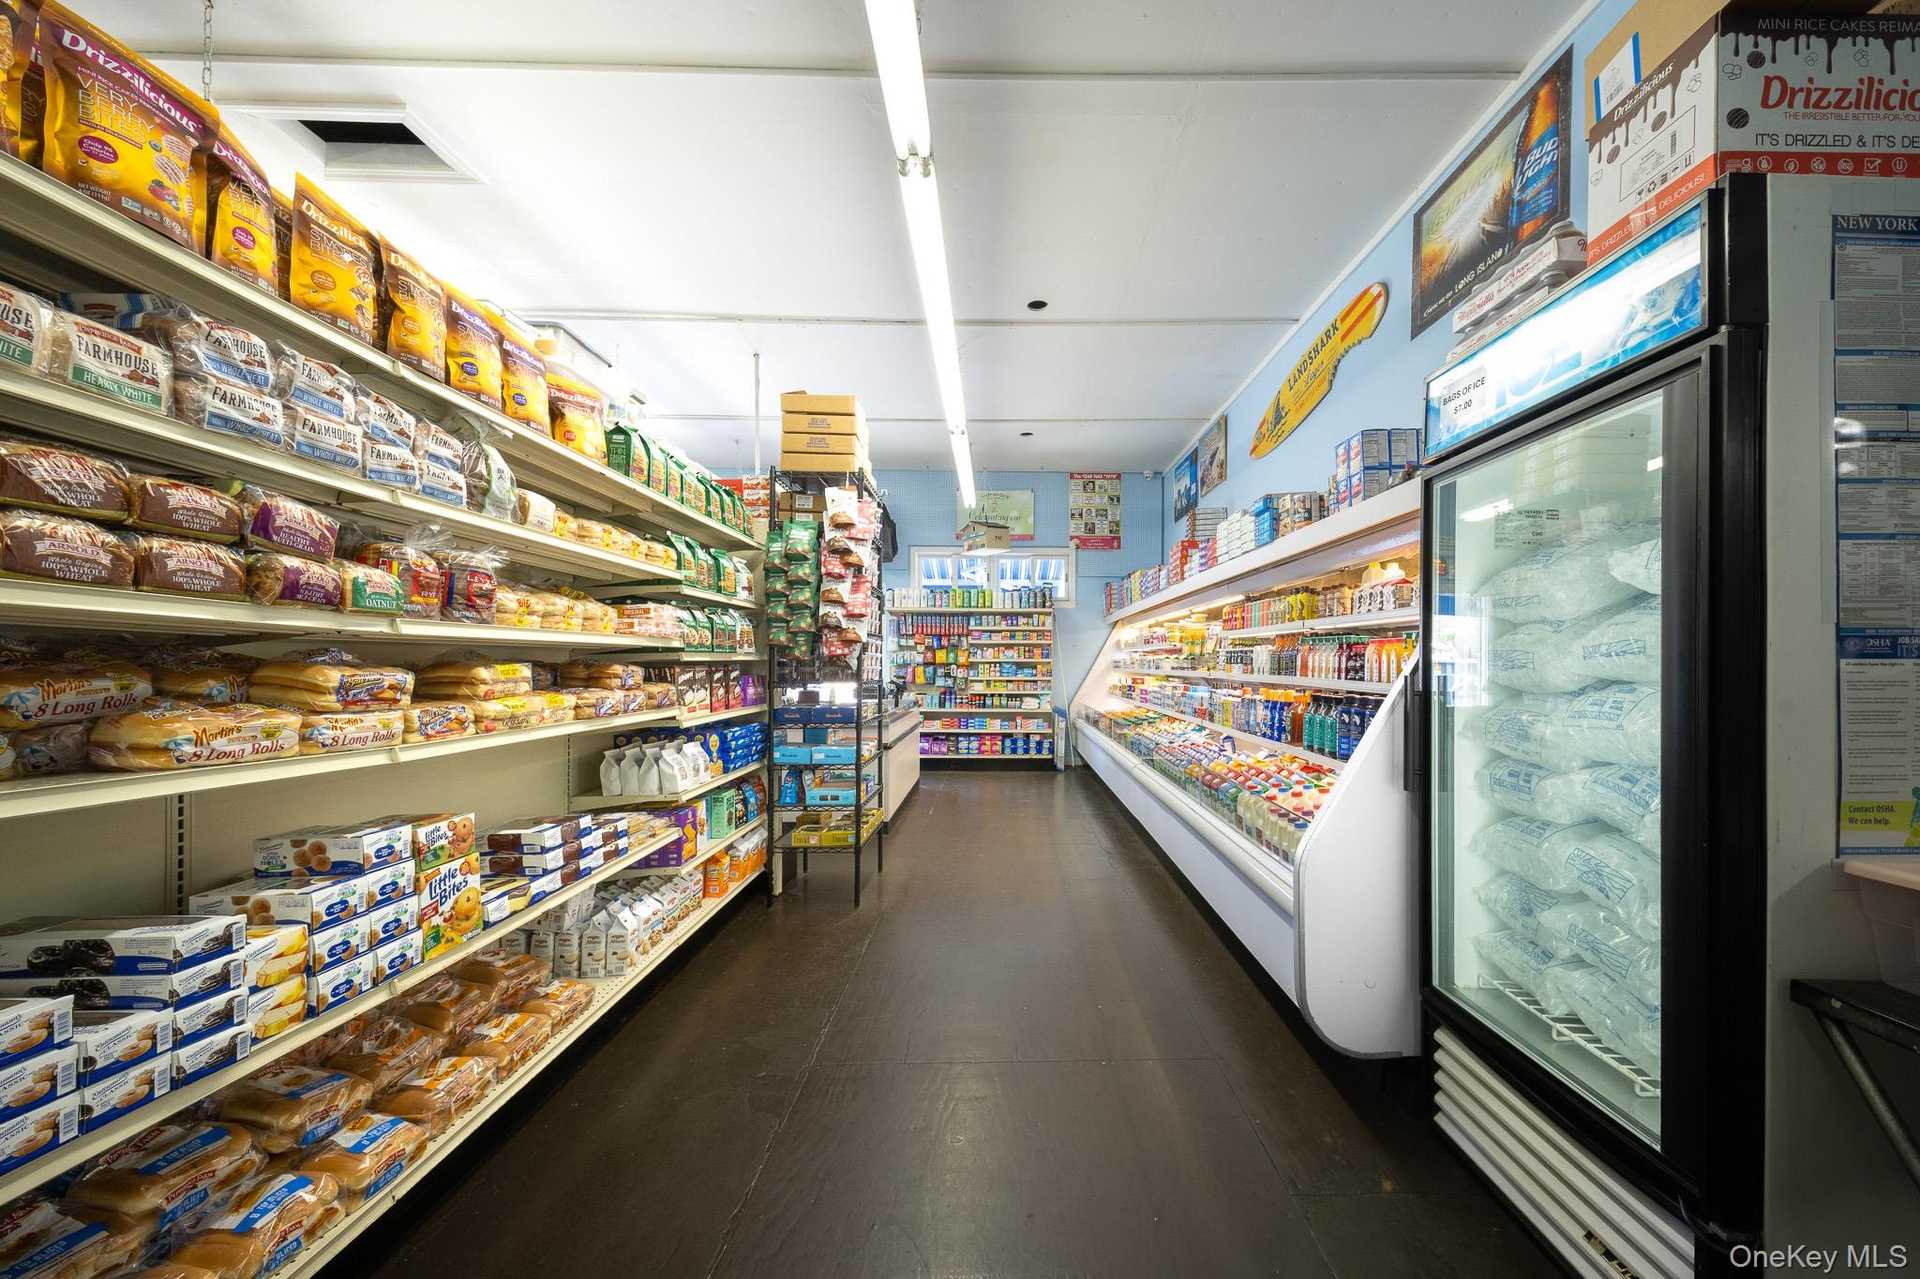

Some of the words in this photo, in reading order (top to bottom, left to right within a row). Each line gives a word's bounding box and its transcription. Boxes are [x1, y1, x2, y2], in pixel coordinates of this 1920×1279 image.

[1757, 18, 1791, 30] MINI
[1794, 19, 1828, 31] RICE
[1830, 20, 1875, 33] CAKES
[62, 29, 197, 132] Drizzilicious
[77, 73, 138, 112] VERY
[1613, 61, 1674, 121] Drizzilicious
[79, 89, 154, 133] BERRY
[1784, 111, 1800, 120] THE
[1802, 112, 1850, 121] IRRESISTIBLE
[79, 104, 146, 143] BITES
[1755, 133, 1780, 146] IT'S
[1785, 134, 1851, 148] DRIZZLED
[1856, 136, 1867, 148] &
[1872, 135, 1896, 148] IT'S
[1524, 137, 1557, 168] BUD
[1515, 150, 1557, 192] LIGHT
[1658, 172, 1706, 209] DELICIOUS!
[1837, 215, 1869, 230] NEW
[1876, 216, 1917, 231] YORK
[1455, 270, 1475, 293] LONG
[1476, 247, 1503, 275] ISLAND
[77, 334, 158, 377] FARMHOUSE
[1287, 318, 1340, 391] LANDSHARK
[121, 386, 153, 404] WHITE
[1442, 389, 1461, 406] BAGS
[1462, 384, 1473, 396] OF
[1473, 375, 1486, 390] ICE
[1453, 399, 1472, 415] $7.00
[302, 418, 358, 445] FARMHOUSE
[314, 447, 335, 460] WHOLE
[334, 453, 356, 467] WHEAT
[172, 513, 194, 523] 100%
[193, 516, 222, 528] WHOLE
[182, 521, 212, 532] WHEAT
[280, 531, 310, 546] HEALTHY
[48, 542, 100, 557] ARNOLD
[41, 561, 69, 571] 100%
[69, 565, 108, 578] WHOLE
[48, 556, 73, 564] Whole
[75, 559, 103, 570] Grains
[54, 570, 94, 582] WHEAT
[172, 576, 193, 585] 100%
[193, 578, 223, 588] WHOLE
[182, 583, 213, 592] WHEAT
[366, 599, 398, 610] OATNUT
[1866, 638, 1891, 646] OSHA
[1897, 636, 1909, 644] JOB
[38, 677, 93, 701] Martin's
[33, 702, 49, 718] 8
[51, 700, 98, 717] Long
[100, 692, 140, 713] Rolls
[193, 723, 243, 748] Martin's
[330, 735, 340, 747] 8
[341, 734, 369, 748] Long
[371, 730, 397, 743] Rolls
[187, 749, 204, 763] 8
[205, 746, 246, 761] Long
[250, 739, 286, 758] Rolls
[1848, 805, 1875, 813] Contact
[1876, 805, 1897, 813] OSHA.
[1848, 817, 1859, 825] We
[1873, 817, 1891, 827] help.
[425, 825, 441, 842] Little
[430, 831, 448, 848] Bites
[429, 867, 459, 901] Little
[439, 877, 469, 907] Bites
